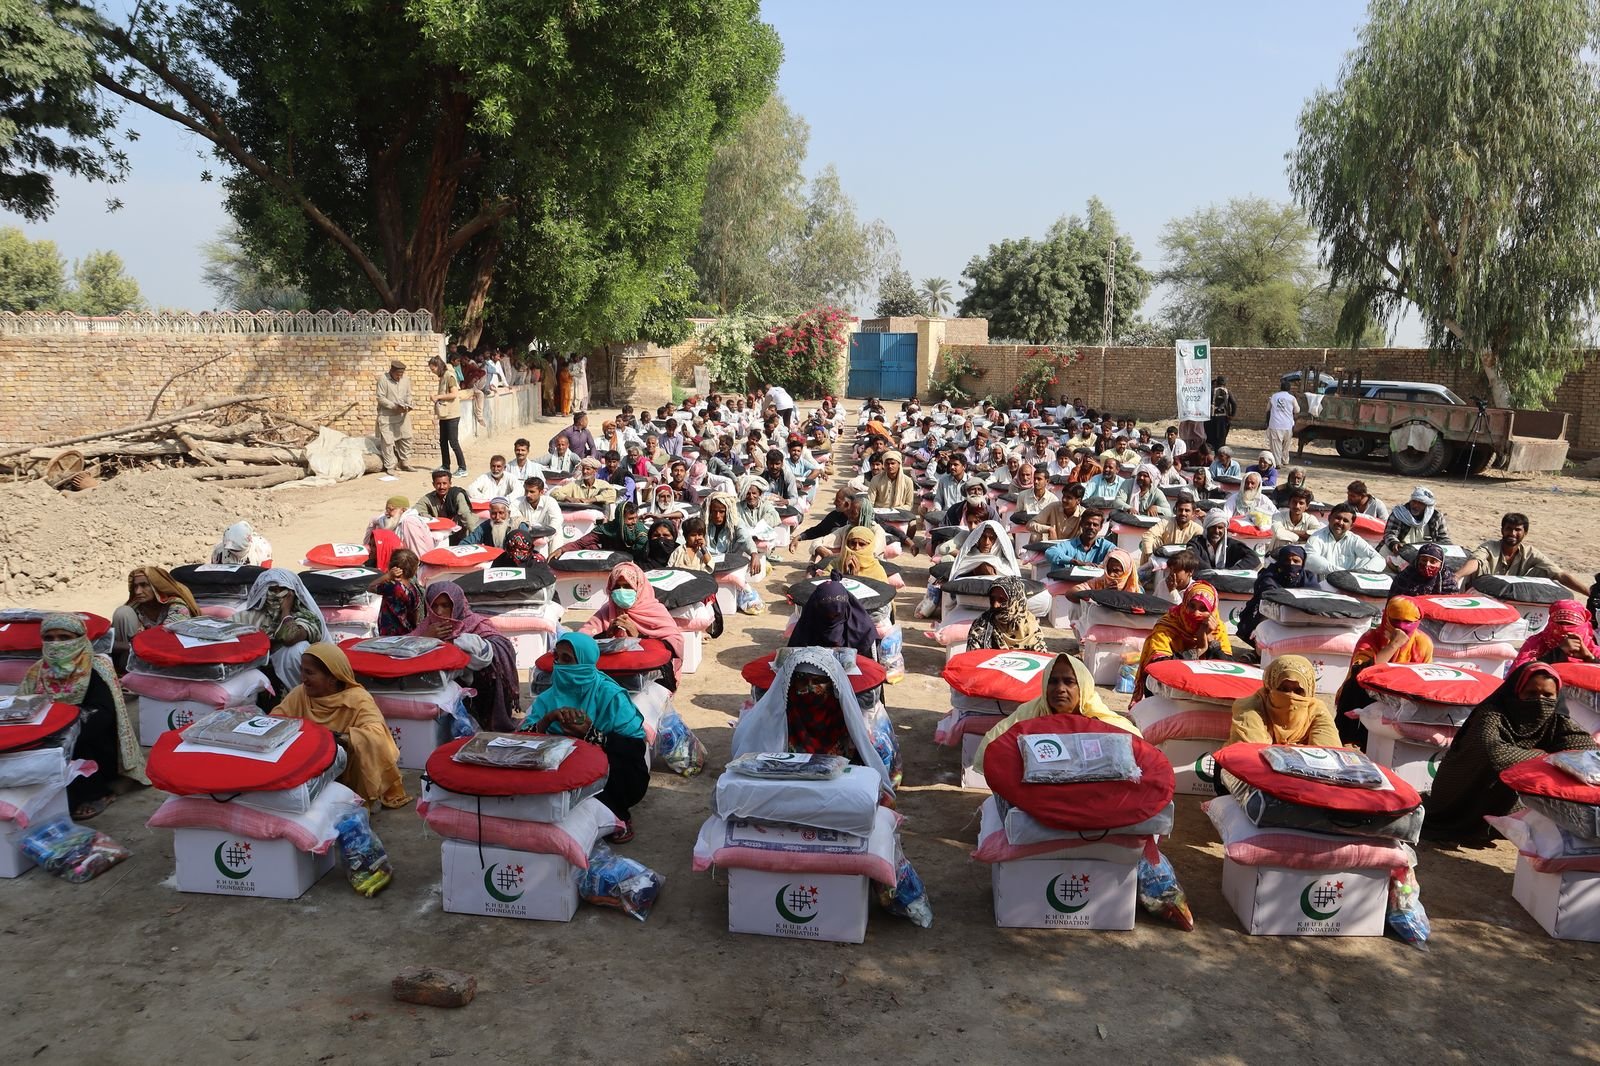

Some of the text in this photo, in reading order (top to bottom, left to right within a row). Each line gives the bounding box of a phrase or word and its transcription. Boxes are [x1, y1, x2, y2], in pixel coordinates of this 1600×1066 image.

[485, 902, 527, 910] KHUBAIB
[485, 907, 527, 915] FOUNDATION
[775, 922, 820, 932] KHUBAIB
[775, 928, 820, 937] FOUNDATION
